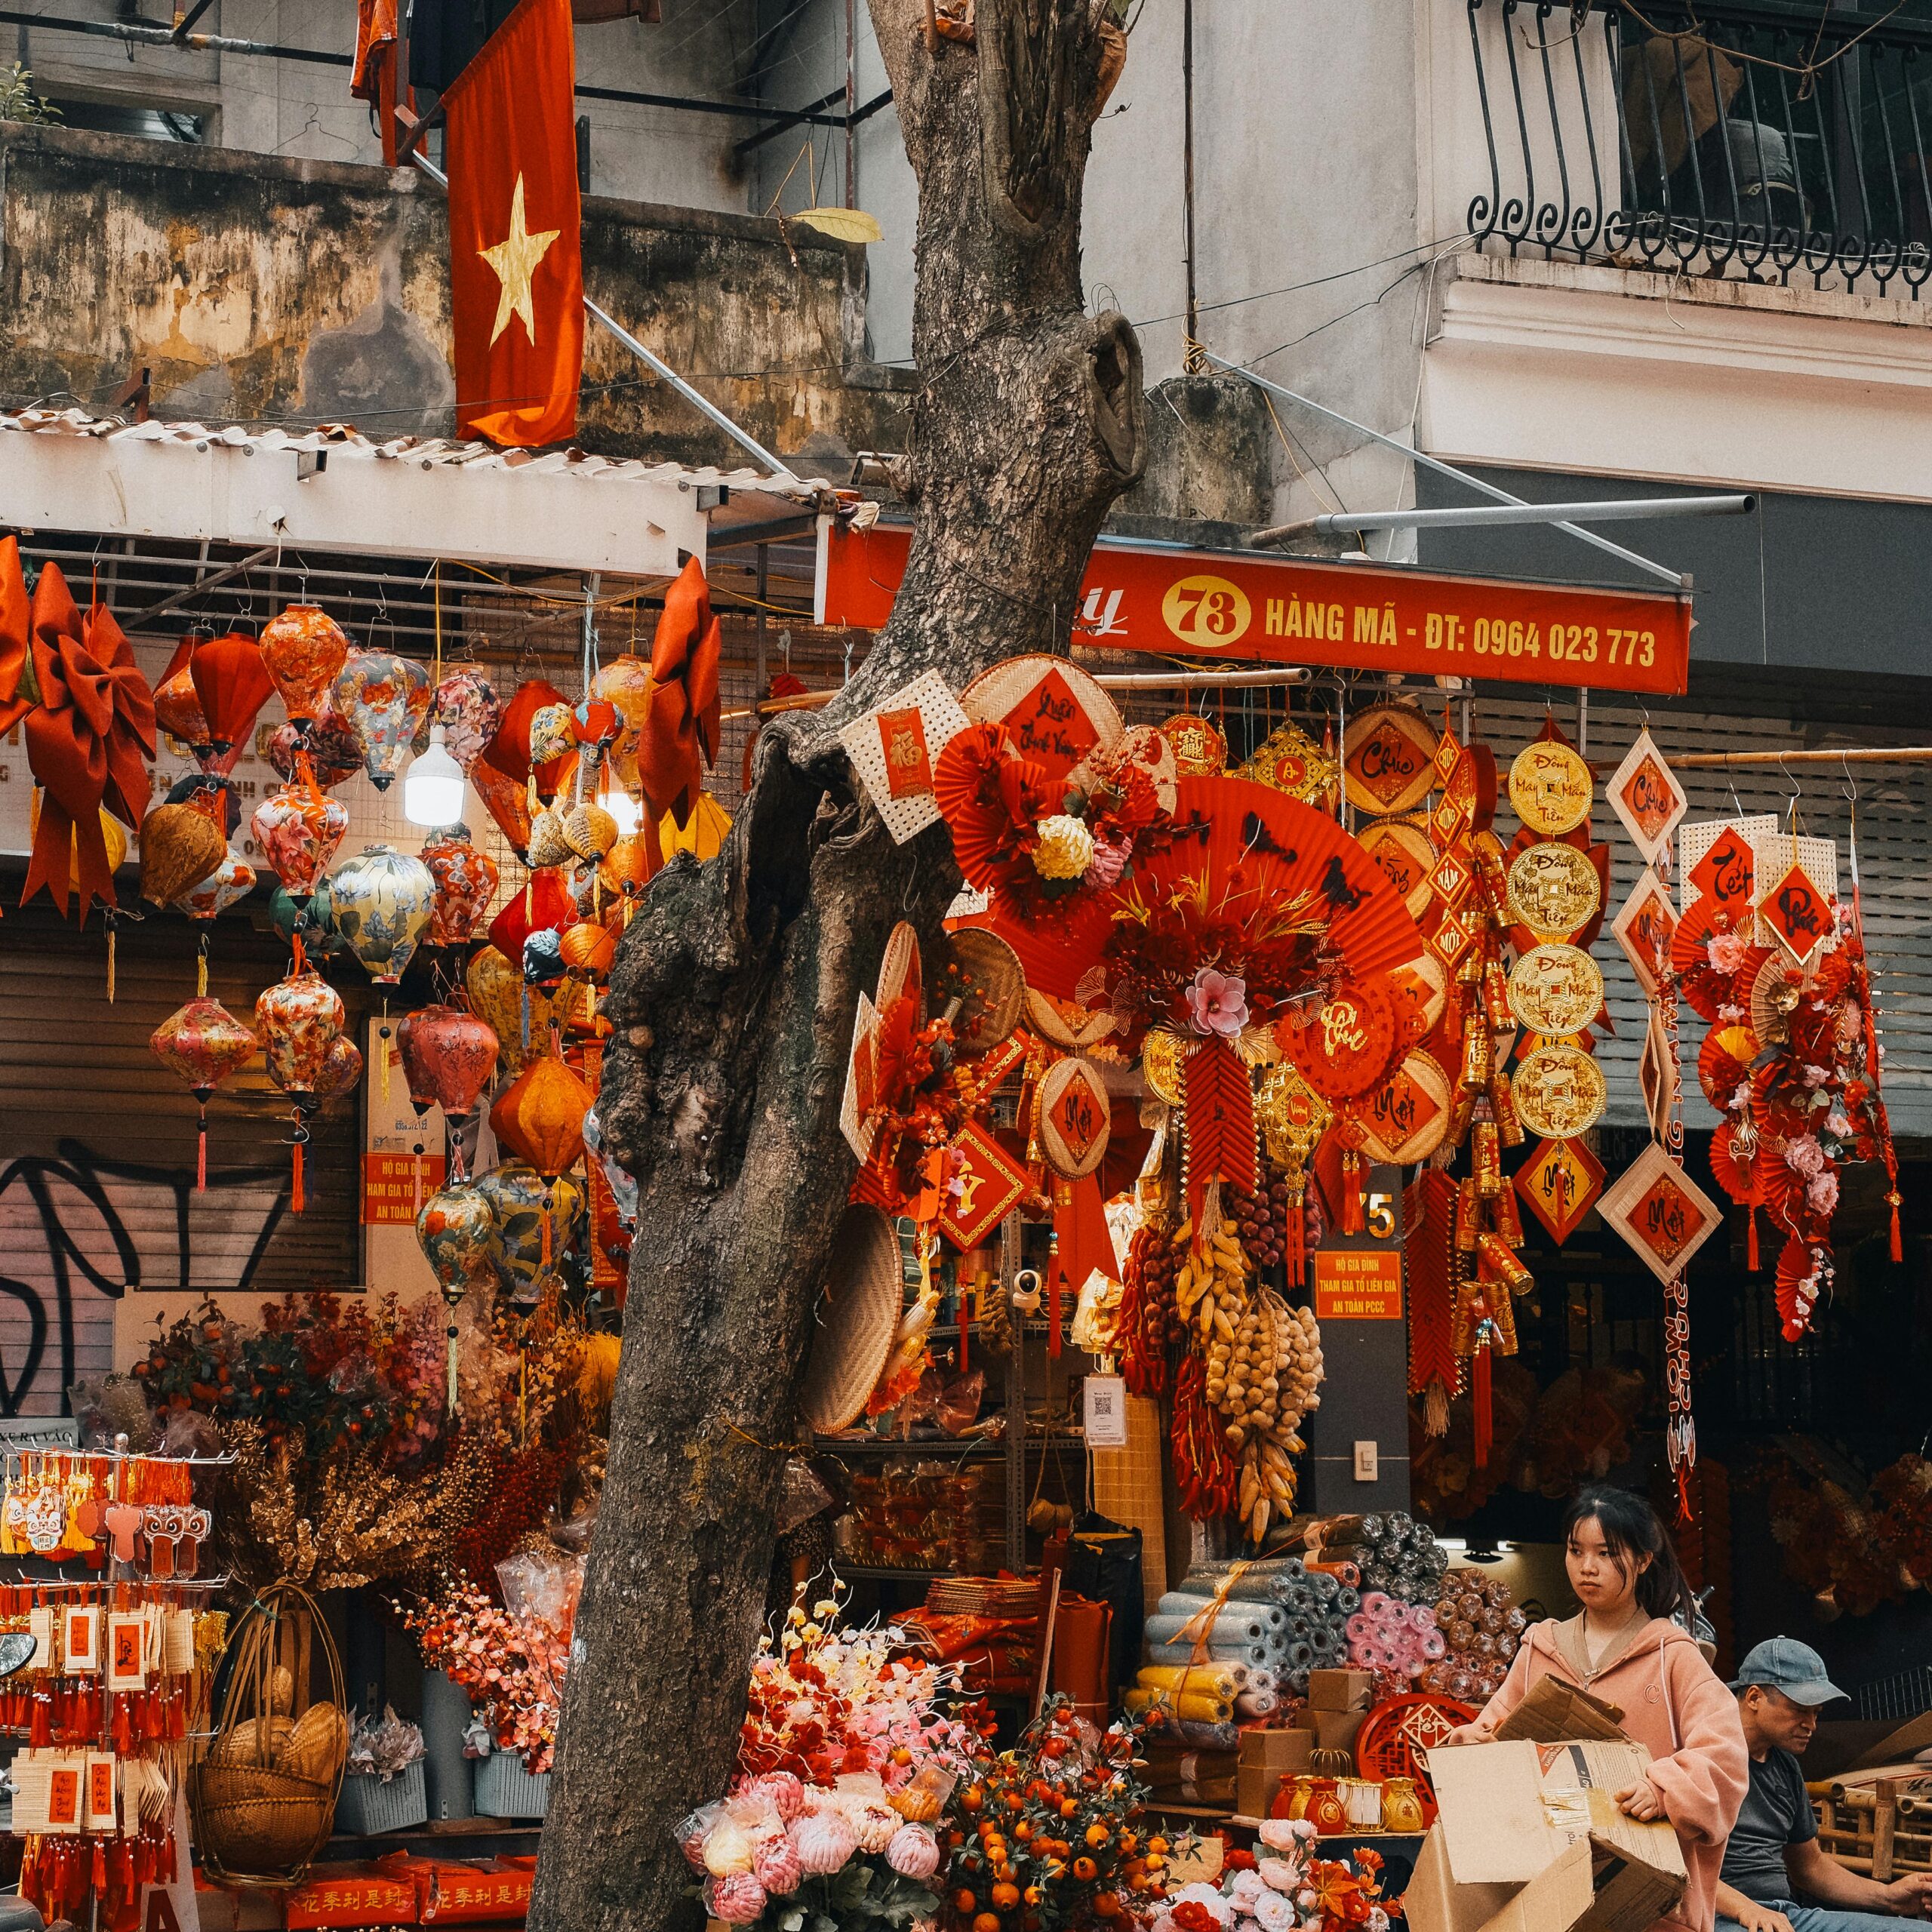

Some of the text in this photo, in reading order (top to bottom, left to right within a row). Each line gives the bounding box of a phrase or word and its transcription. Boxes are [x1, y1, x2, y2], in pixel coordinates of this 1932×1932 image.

[1177, 586, 1238, 635] 73
[1266, 592, 1344, 641] HÀNG
[1354, 601, 1398, 646] MÃ
[1425, 613, 1466, 651] ĐT:
[1474, 617, 1540, 657] 0964
[1549, 624, 1598, 662] 023
[1606, 629, 1655, 667] 773
[889, 730, 922, 768] 福
[1361, 740, 1414, 779] Chúc
[1438, 743, 1455, 769] CHÚC
[1533, 753, 1570, 782] Đồng
[1515, 777, 1586, 805] May Mắn
[1632, 775, 1668, 814] Chúc
[1438, 801, 1457, 829] MỪNG
[1538, 807, 1565, 822] Tiền
[1436, 862, 1459, 892] NĂM
[1533, 853, 1575, 881] Đồng
[1712, 844, 1754, 902] Tết
[1514, 879, 1540, 907] May
[1538, 906, 1569, 923] Tiền
[1778, 887, 1821, 938] Phúc
[1439, 925, 1461, 954] MỚI
[1534, 955, 1577, 982] Đồng
[1515, 981, 1541, 1008] May
[1568, 981, 1597, 997] Mắn
[1537, 1057, 1579, 1084] Đồng
[1065, 1094, 1092, 1143] Mới
[1371, 1086, 1416, 1131] Mới
[382, 1159, 431, 1177] HỘ GIA ĐNH
[388, 1183, 401, 1197] GIA
[404, 1180, 414, 1198] TỔ
[376, 1205, 388, 1219] AN
[391, 1203, 411, 1220] TOÀN
[1646, 1196, 1685, 1243] Mới
[1336, 1257, 1379, 1274] HỘ GIA ĐÌNH
[1319, 1275, 1397, 1292] THAM GIA TỔ LIÊN GIA
[1333, 1298, 1385, 1313] AN TOÀN PCCC
[20, 1432, 38, 1442] RA
